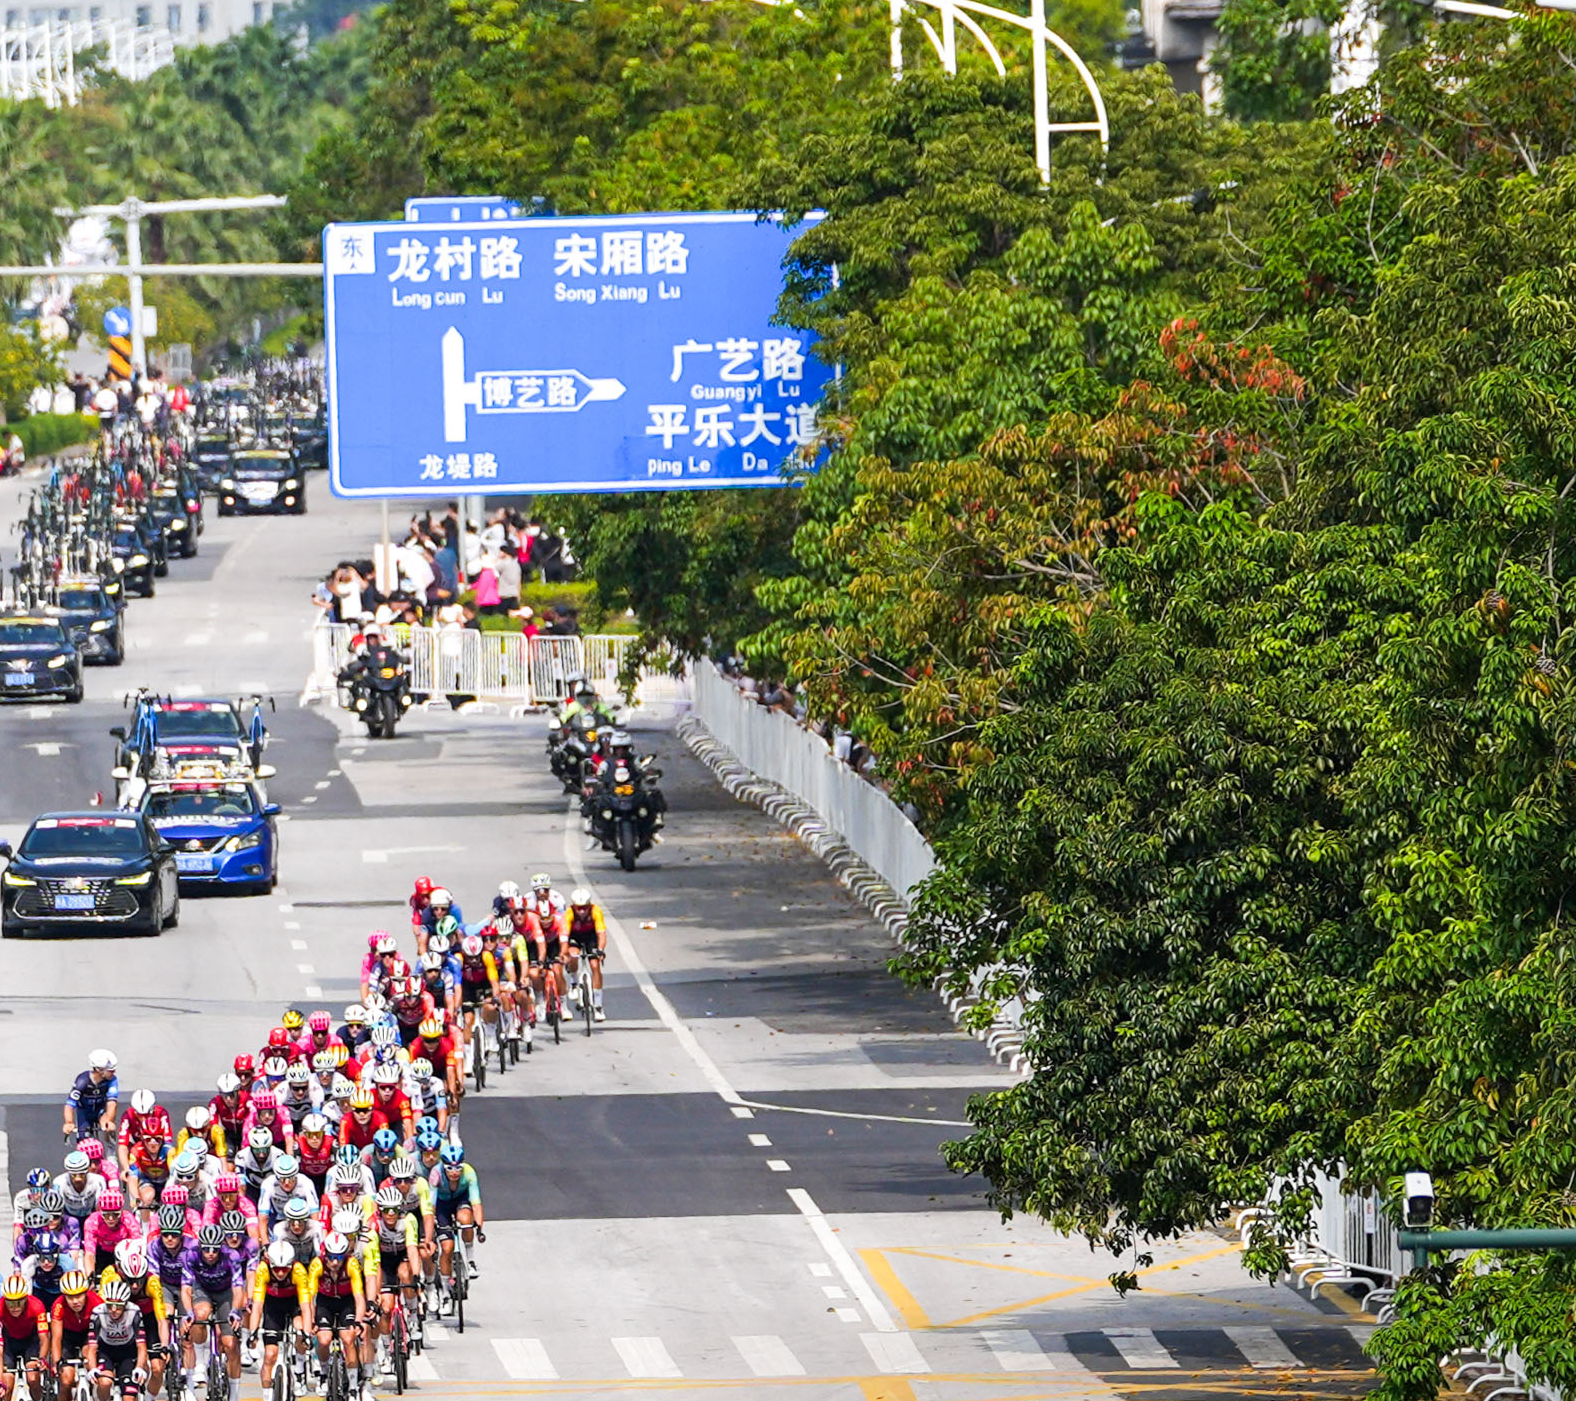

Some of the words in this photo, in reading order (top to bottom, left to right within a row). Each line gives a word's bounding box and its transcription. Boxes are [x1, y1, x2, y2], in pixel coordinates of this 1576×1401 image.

[341, 235, 363, 259] 东
[387, 235, 523, 283] 龙村路
[553, 230, 690, 277] 宋厢路
[392, 287, 432, 310] Long
[482, 286, 504, 304] Lu
[554, 282, 597, 305] Song
[601, 284, 648, 304] Xiang
[658, 280, 681, 300] Lu
[670, 337, 806, 383] 广艺路
[484, 376, 577, 407] 博艺路
[777, 380, 800, 397] Lu
[645, 402, 823, 449] 平乐大道
[419, 452, 498, 480] 龙堤路
[688, 455, 712, 473] Le
[742, 452, 769, 471] Da
